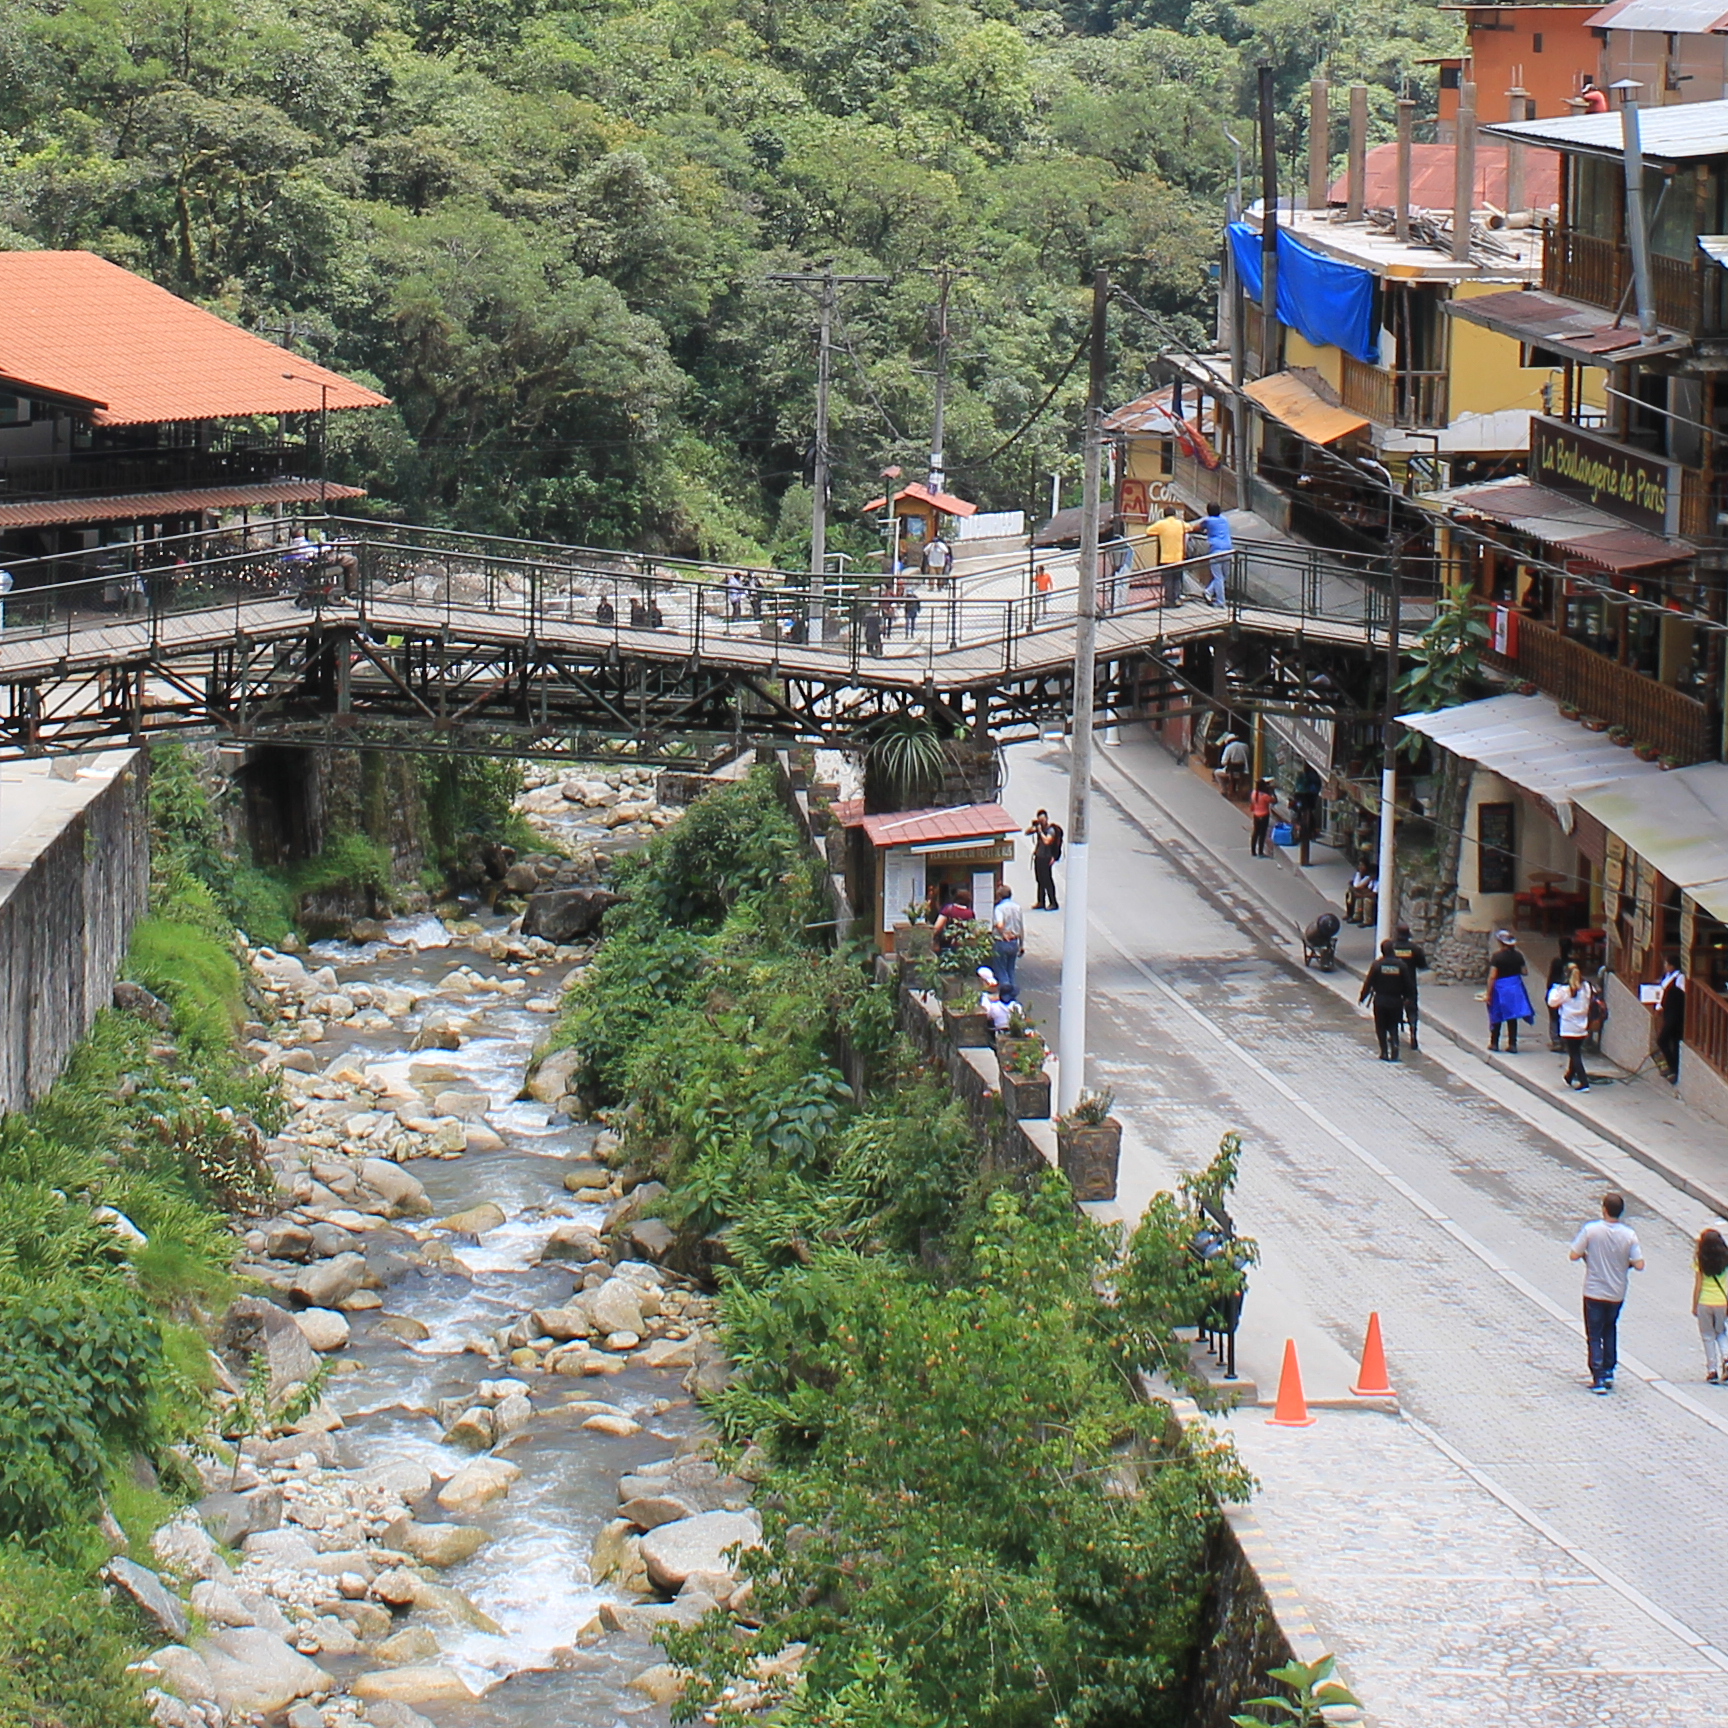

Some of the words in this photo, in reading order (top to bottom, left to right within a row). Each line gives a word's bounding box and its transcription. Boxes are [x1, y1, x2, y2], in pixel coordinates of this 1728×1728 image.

[1542, 435, 1554, 470] La
[1557, 438, 1618, 503] Boulangerie
[1620, 459, 1633, 502] de
[1637, 468, 1666, 514] Paris
